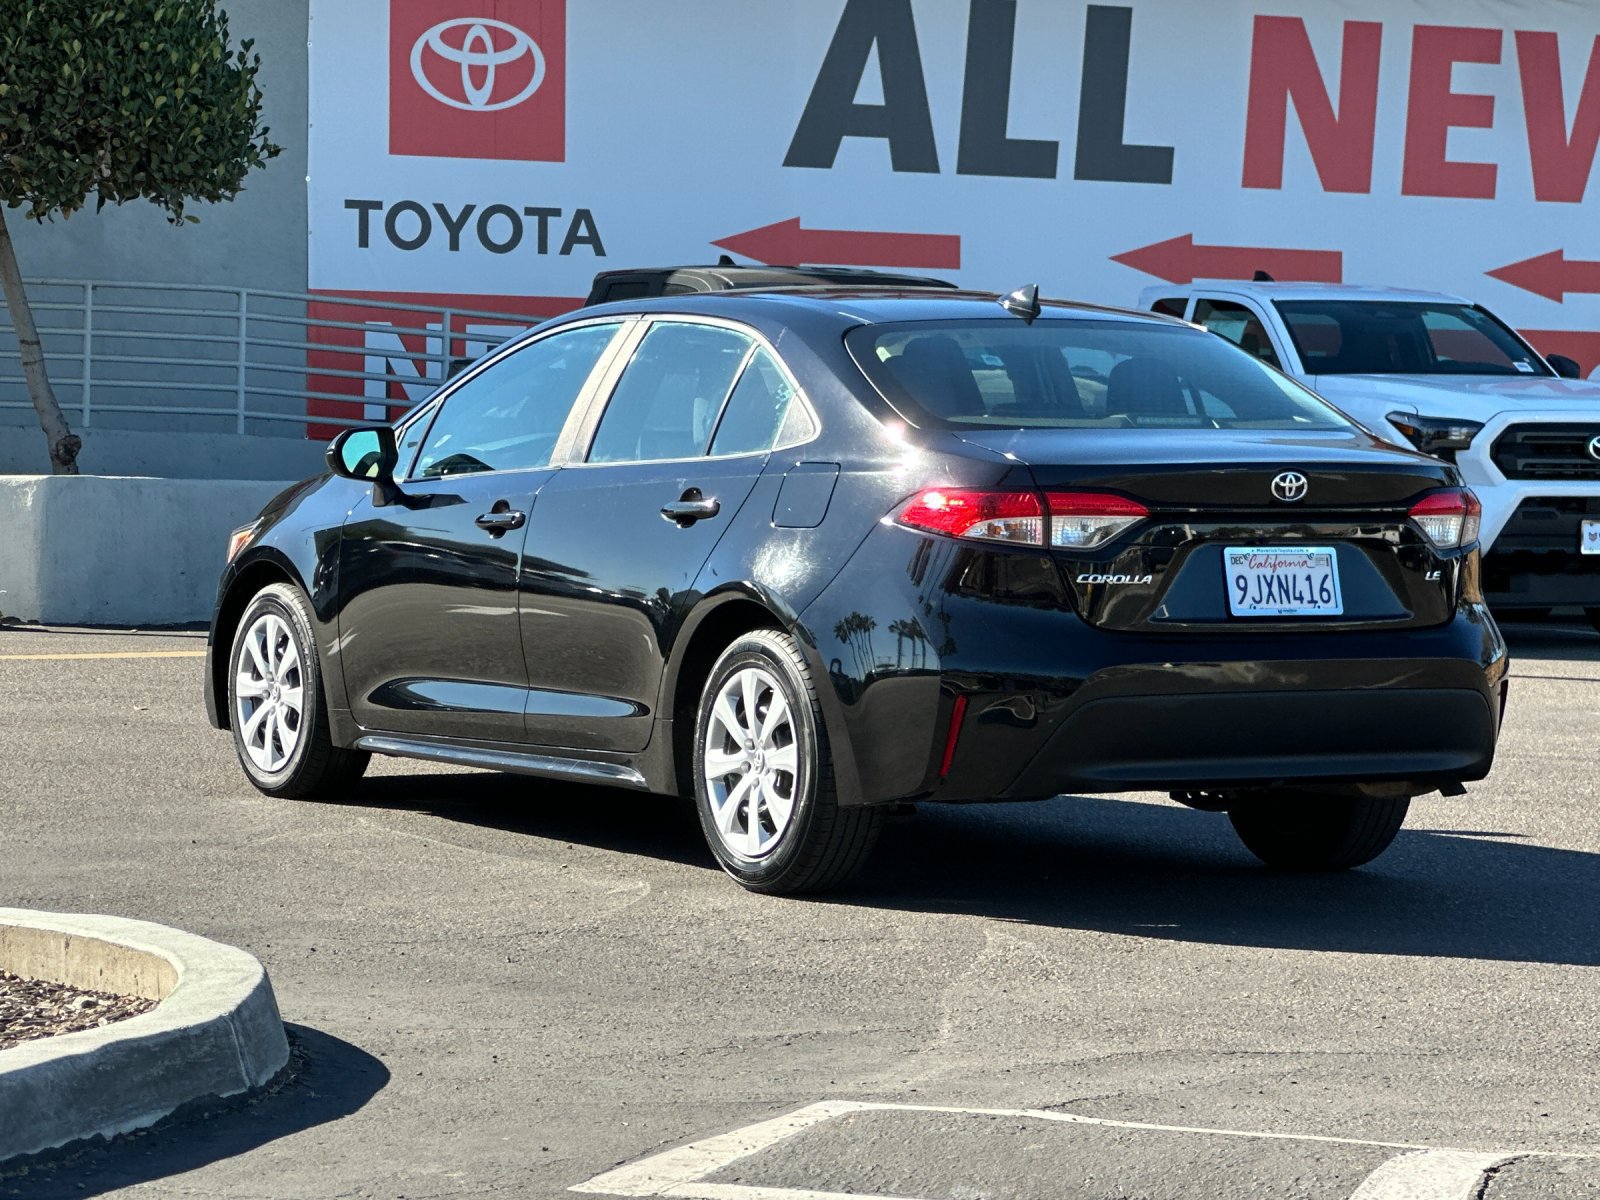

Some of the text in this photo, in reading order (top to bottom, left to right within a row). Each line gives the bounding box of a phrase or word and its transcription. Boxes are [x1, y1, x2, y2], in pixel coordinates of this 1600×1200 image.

[782, 0, 1175, 185] ALL
[344, 198, 607, 257] TOYOTA
[1230, 556, 1244, 565] DEC
[1248, 553, 1316, 573] California
[1076, 574, 1153, 584] COROLLA
[1425, 571, 1441, 580] LE
[1235, 573, 1332, 605] 9JXN416
